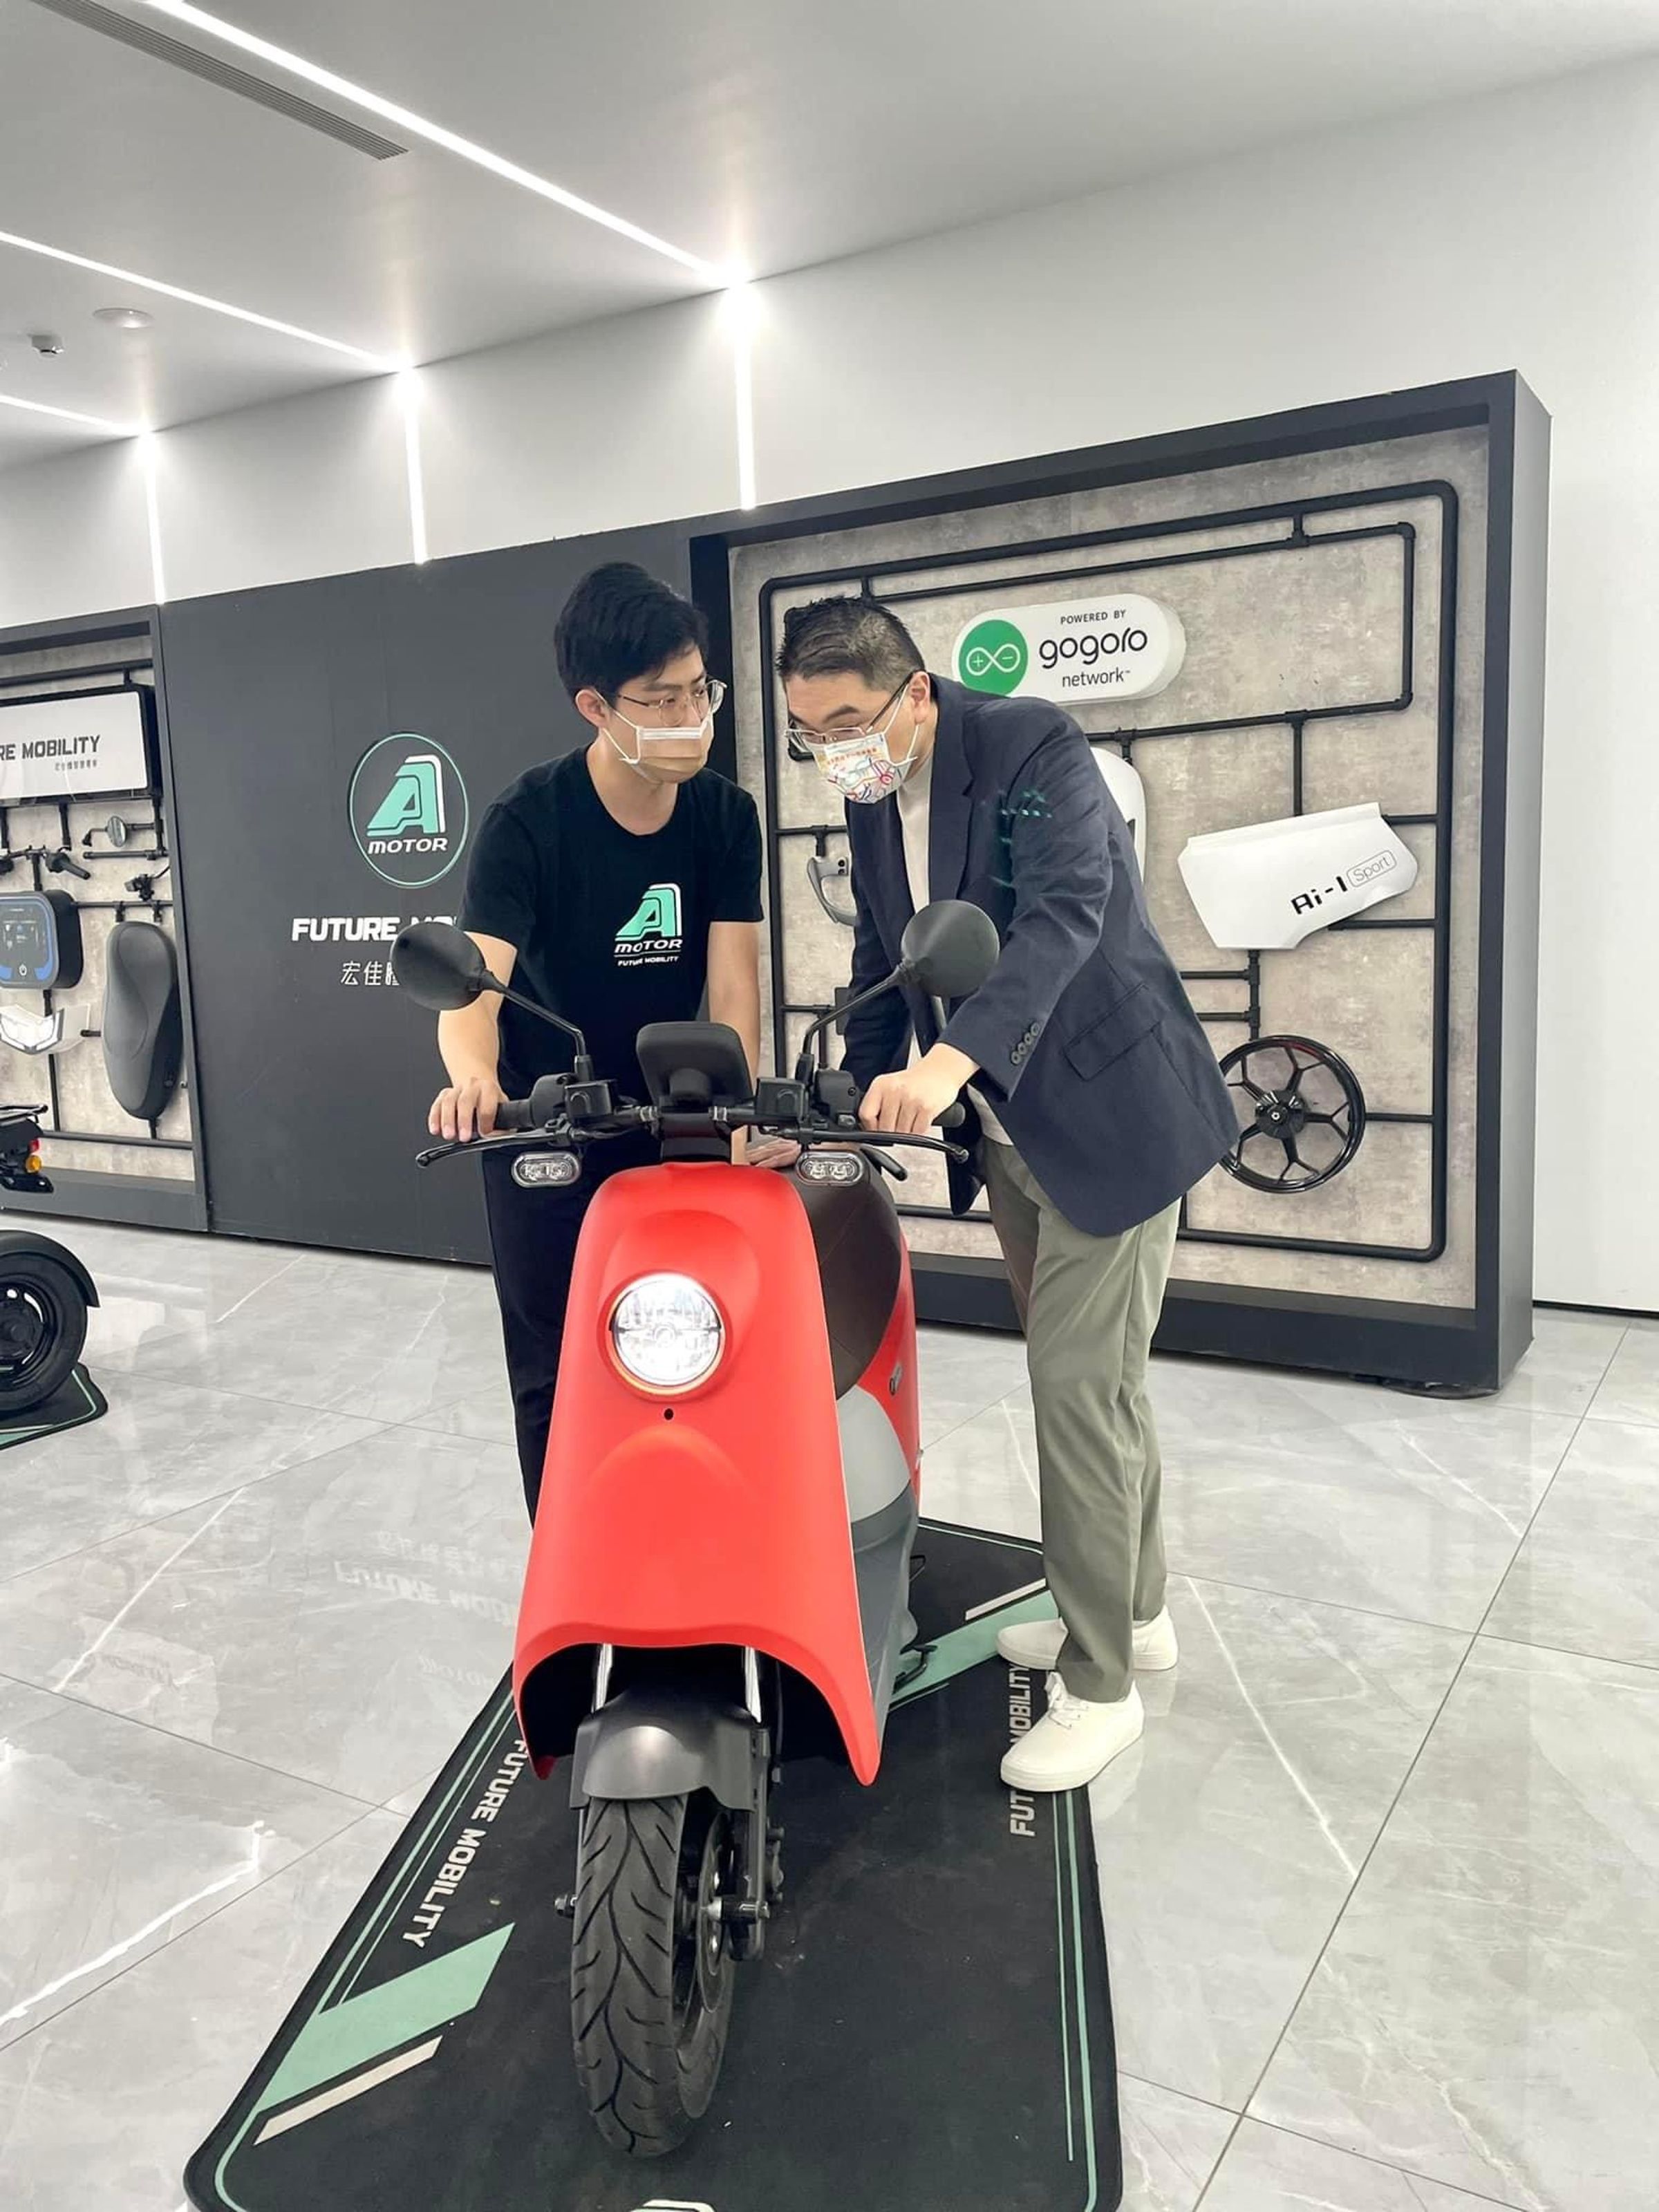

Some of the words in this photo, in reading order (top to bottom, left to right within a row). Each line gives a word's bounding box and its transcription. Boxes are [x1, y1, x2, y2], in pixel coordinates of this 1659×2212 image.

[1060, 612, 1107, 625] POWERED
[1114, 610, 1126, 619] BY
[1039, 628, 1147, 669] gogoro
[21, 734, 100, 759] MOBILITY
[1353, 857, 1390, 882] Sport
[292, 917, 400, 941] FUTURE
[614, 939, 683, 953] MOTOR
[402, 1828, 487, 1948] MOBILITY
